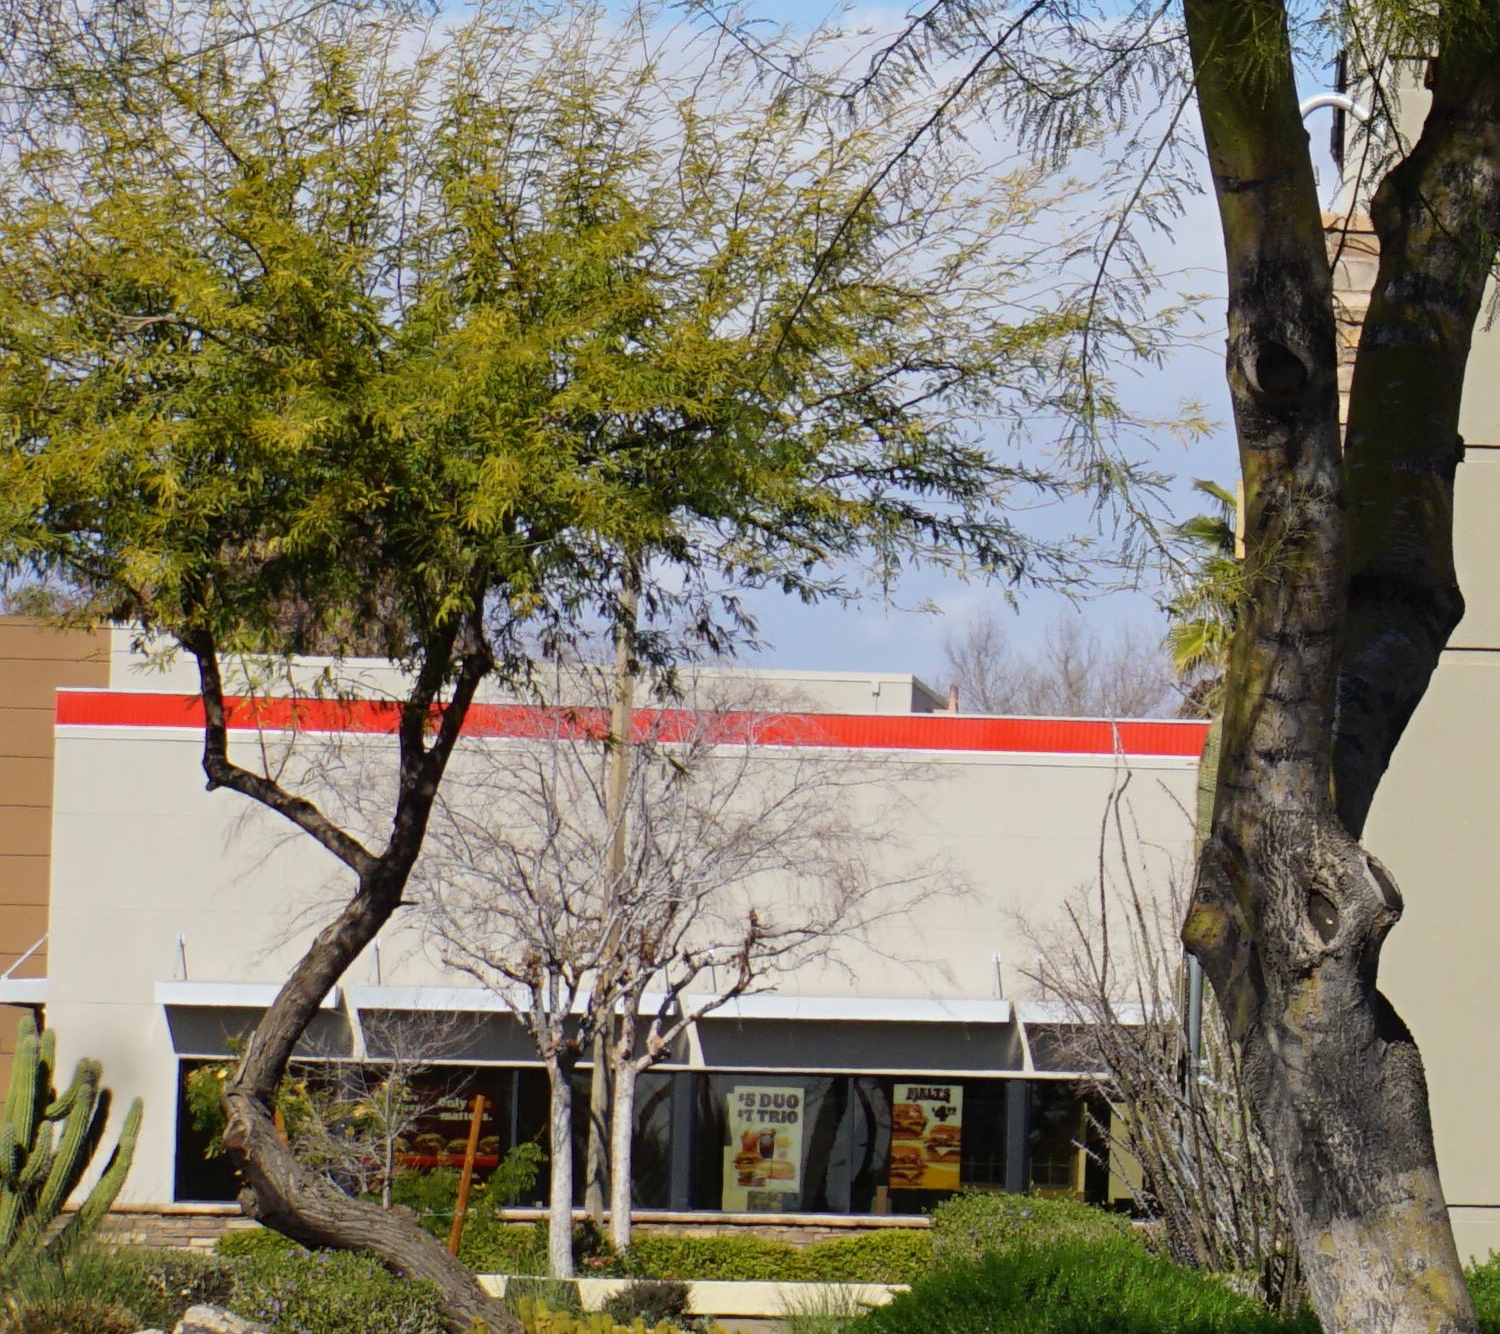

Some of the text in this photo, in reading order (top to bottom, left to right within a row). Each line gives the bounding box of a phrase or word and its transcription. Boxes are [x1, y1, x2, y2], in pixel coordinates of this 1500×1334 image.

[739, 1093, 800, 1109] $5 DUO
[906, 1087, 951, 1104] MELTS
[757, 1109, 799, 1124] TRIO
